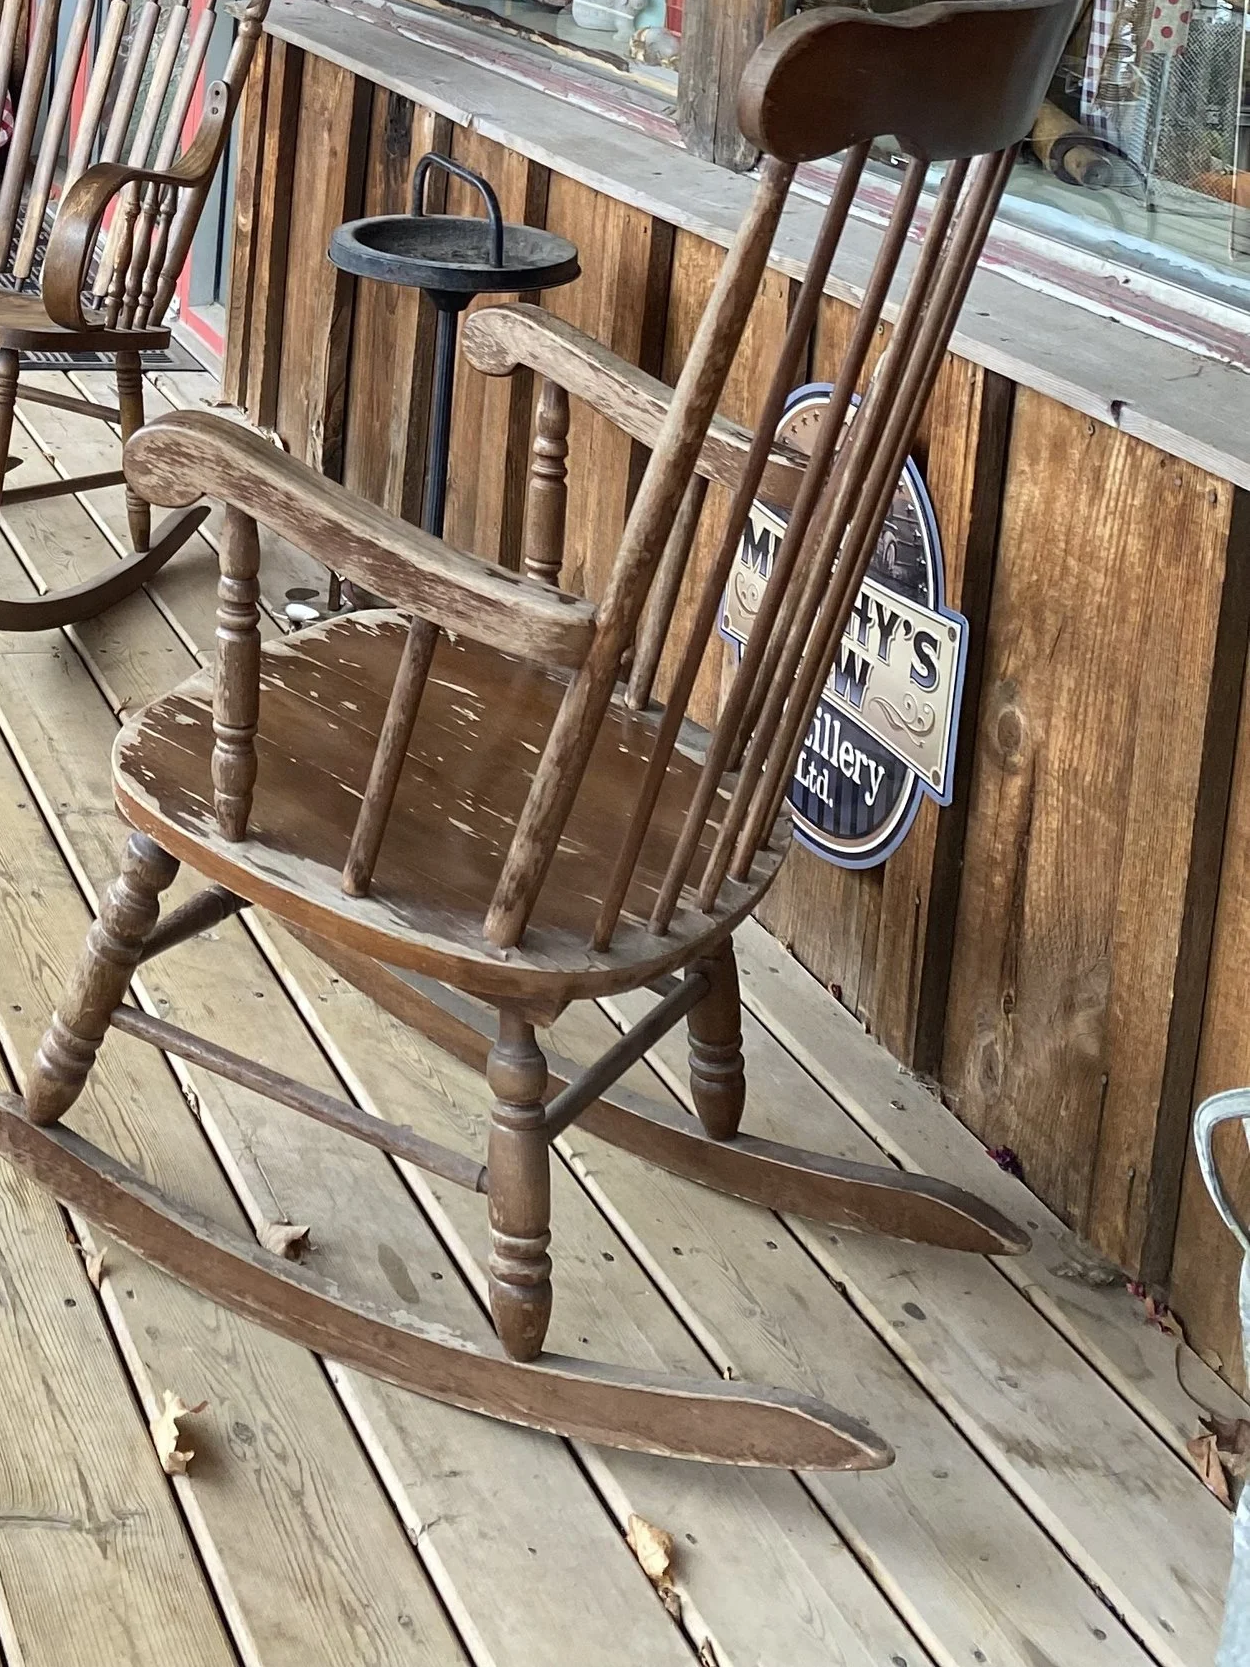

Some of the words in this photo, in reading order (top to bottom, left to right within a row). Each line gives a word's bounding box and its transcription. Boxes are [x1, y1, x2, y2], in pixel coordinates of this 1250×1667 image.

[740, 515, 940, 691] MHY'S
[794, 749, 834, 808] Ltd.
[804, 705, 886, 807] illery
